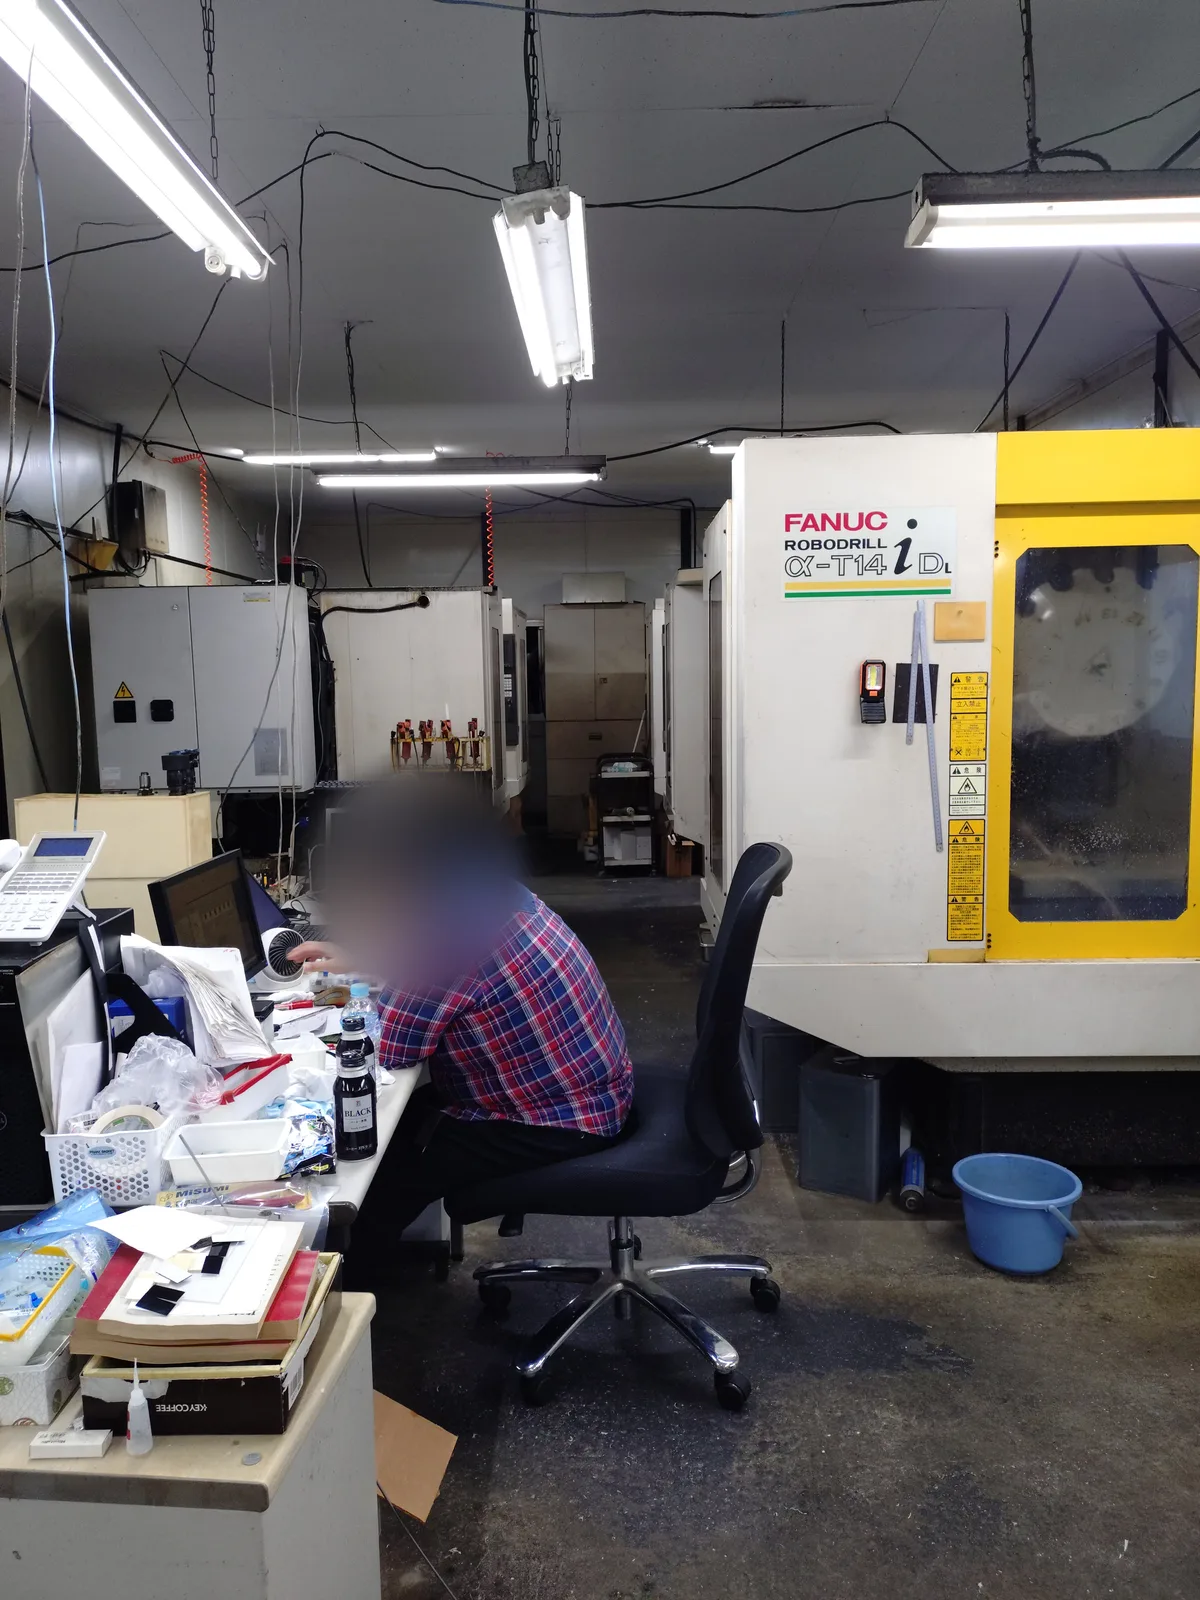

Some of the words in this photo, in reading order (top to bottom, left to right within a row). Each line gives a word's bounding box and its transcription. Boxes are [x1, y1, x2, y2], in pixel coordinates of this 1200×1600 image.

[785, 511, 888, 532] FANUC
[785, 538, 887, 551] ROBODRILL
[956, 700, 982, 708] 立入禁止
[345, 1106, 372, 1118] BLACK
